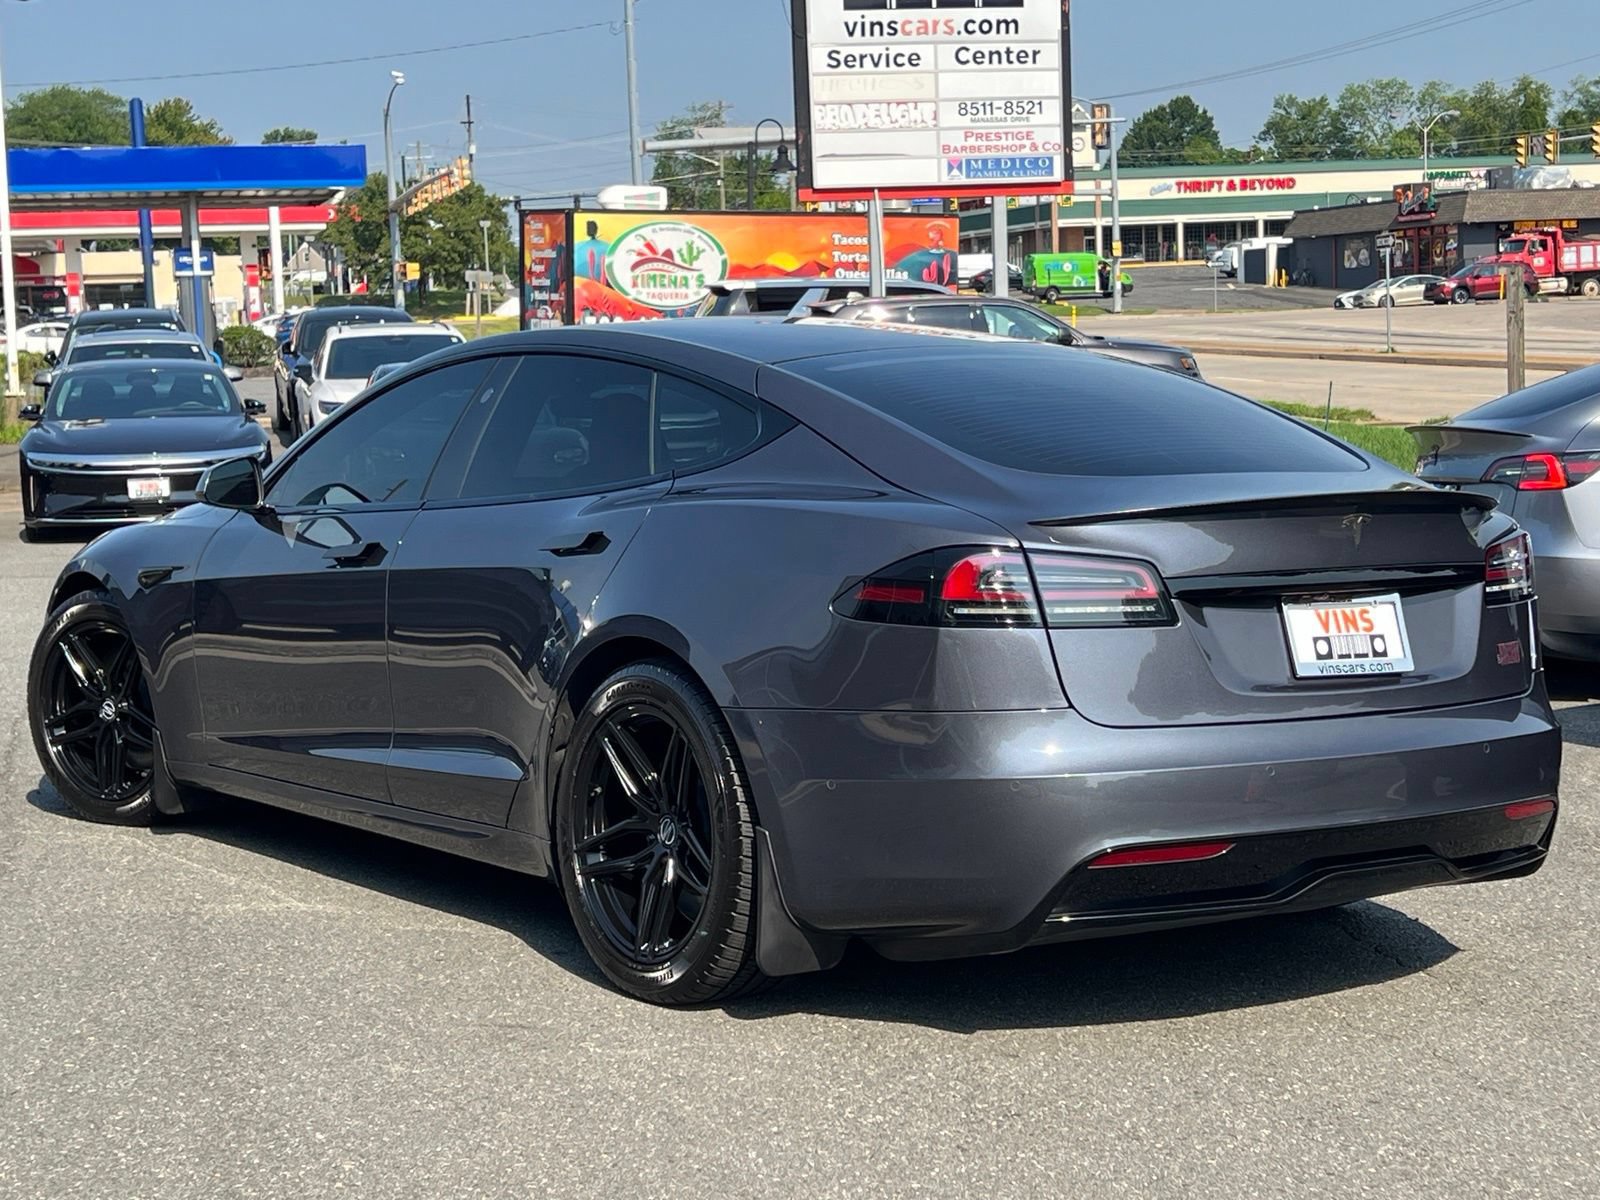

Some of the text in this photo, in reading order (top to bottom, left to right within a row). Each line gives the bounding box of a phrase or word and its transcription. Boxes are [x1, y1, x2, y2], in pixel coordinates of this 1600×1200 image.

[844, 14, 1019, 37] vinscars.com
[826, 46, 1041, 69] Service Center
[958, 100, 1043, 116] 8511-8521
[963, 130, 1035, 142] PRESTIGE
[942, 144, 1026, 154] BARBERSHOP
[1029, 142, 1039, 152] &
[970, 158, 1050, 169] MEDICO
[970, 170, 1010, 178] FAMILY
[1012, 169, 1049, 177] CLINIC
[1175, 180, 1224, 193] THRIFT
[1226, 179, 1237, 192] &
[1239, 177, 1296, 191] BEYOND
[832, 233, 868, 245] Tacos
[832, 250, 869, 262] Torta
[631, 273, 705, 289] XIMENA'S
[646, 292, 689, 301] TAQUERIA
[1314, 608, 1374, 634] VINS
[1318, 662, 1394, 675] vinscars.com
